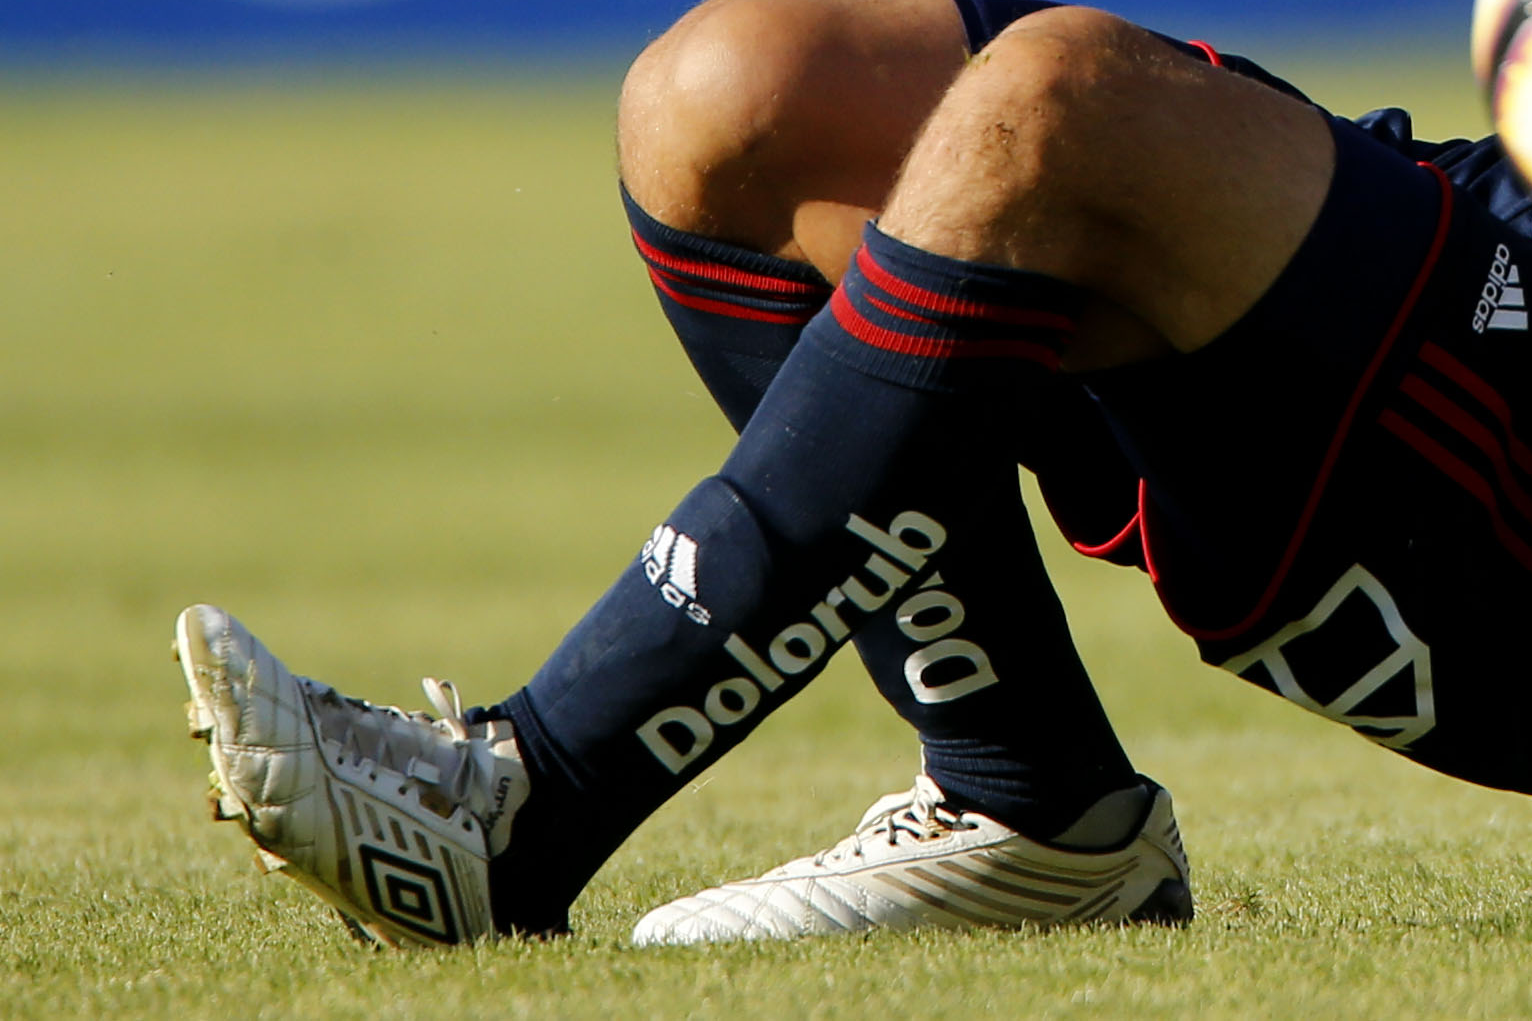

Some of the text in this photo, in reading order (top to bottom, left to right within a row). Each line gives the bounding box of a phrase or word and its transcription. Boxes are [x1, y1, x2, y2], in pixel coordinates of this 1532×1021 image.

[1472, 243, 1510, 334] adidas
[635, 510, 947, 775] Dolorub
[896, 570, 1000, 705] Do
